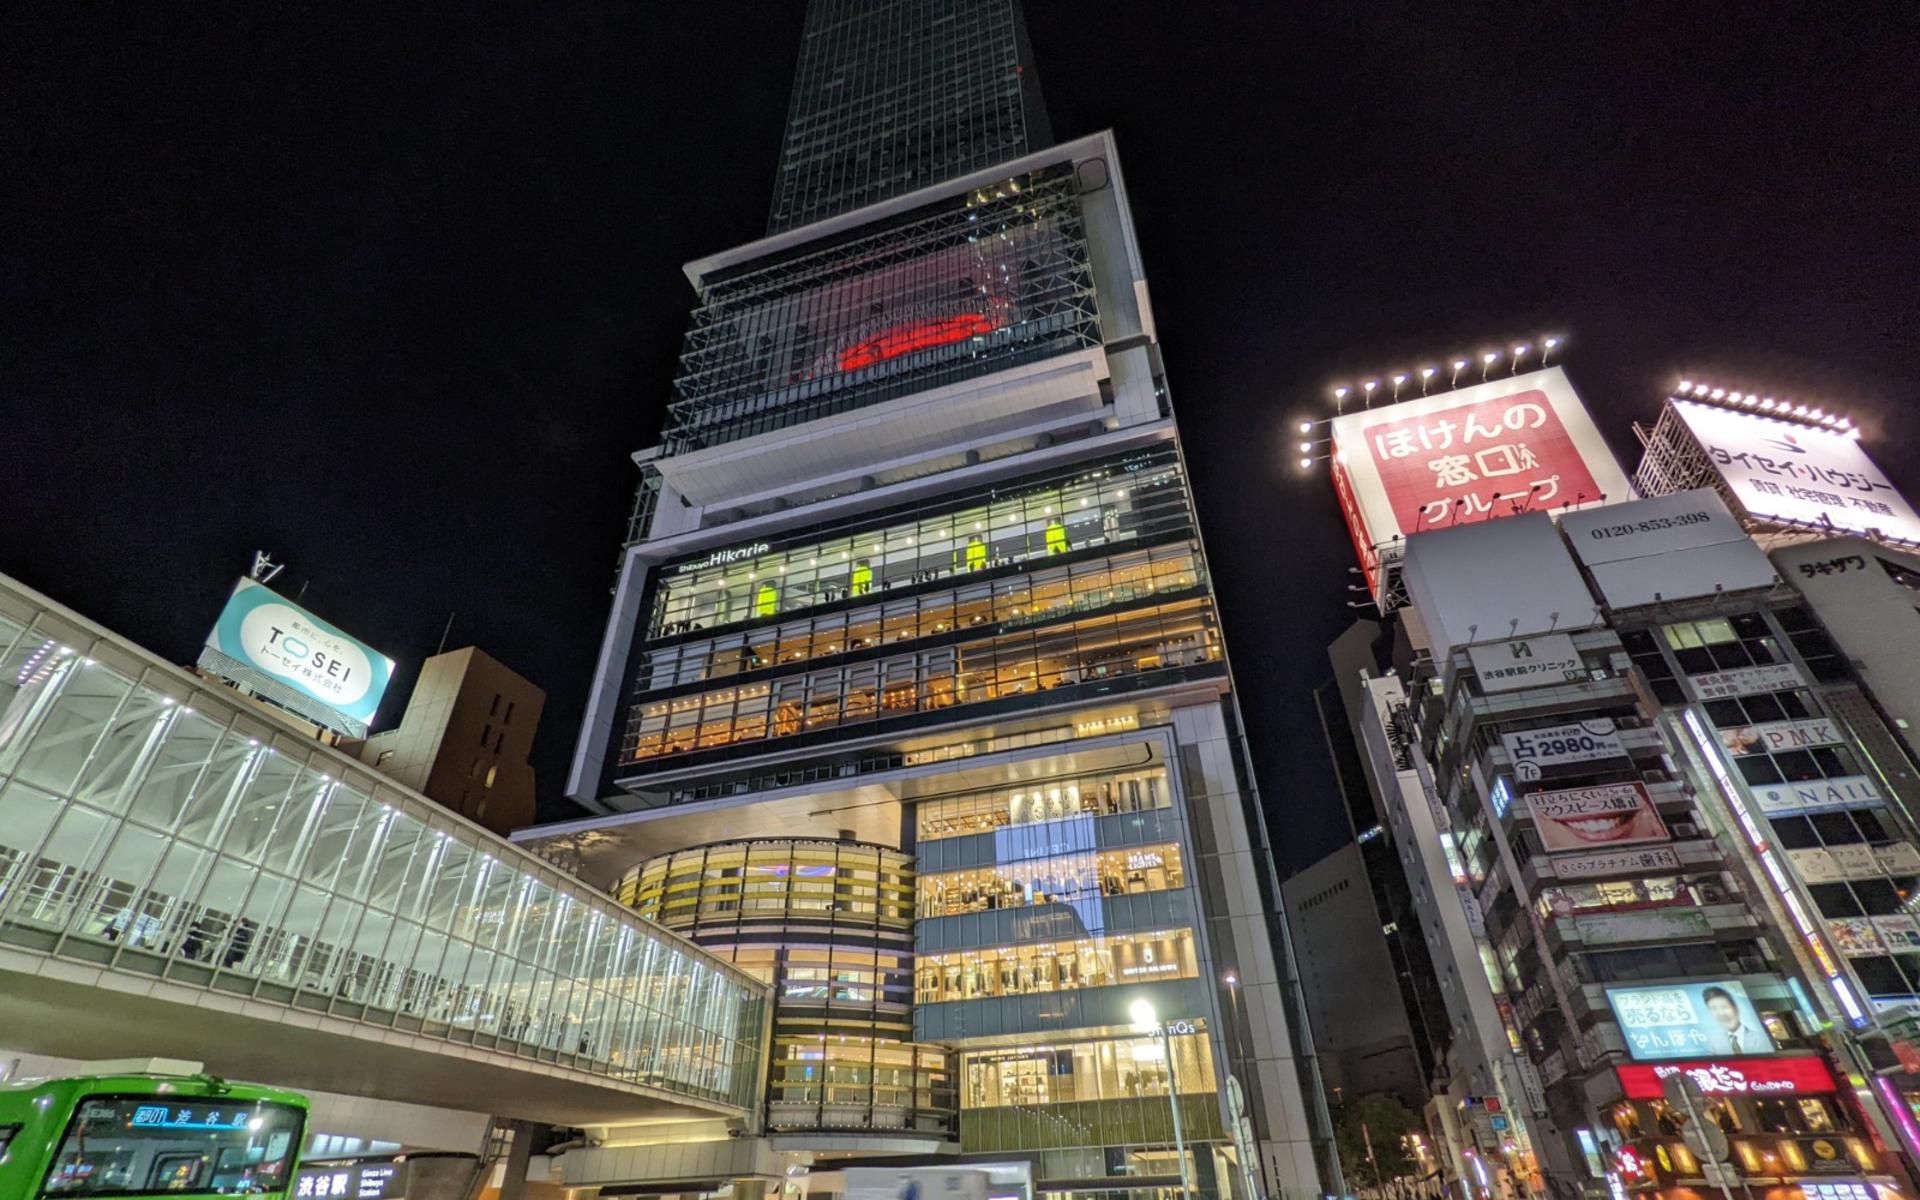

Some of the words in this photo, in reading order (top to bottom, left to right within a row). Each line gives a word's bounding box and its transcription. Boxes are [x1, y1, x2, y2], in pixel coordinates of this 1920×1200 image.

[1376, 403, 1547, 461] ほけんの
[1427, 444, 1523, 488] 窓口
[1424, 474, 1560, 524] グループ
[1591, 511, 1711, 540] 0120-853-398
[710, 543, 769, 566] Hikarie
[1799, 555, 1866, 577] タキザワ
[269, 626, 351, 682] TOSEI
[1482, 659, 1577, 680] 渋谷駅前クリニック
[1766, 726, 1837, 749] PMK
[1519, 765, 1538, 780] 7F
[1533, 790, 1601, 807] 目立ちにくい
[1797, 783, 1877, 804] NAIL
[1541, 797, 1638, 817] マウスピース矯正
[1560, 851, 1674, 873] さくらプラチナム歯科
[1624, 1004, 1692, 1025] 売るなら
[136, 1107, 167, 1124] 都01
[297, 1173, 349, 1197] 渋谷駅
